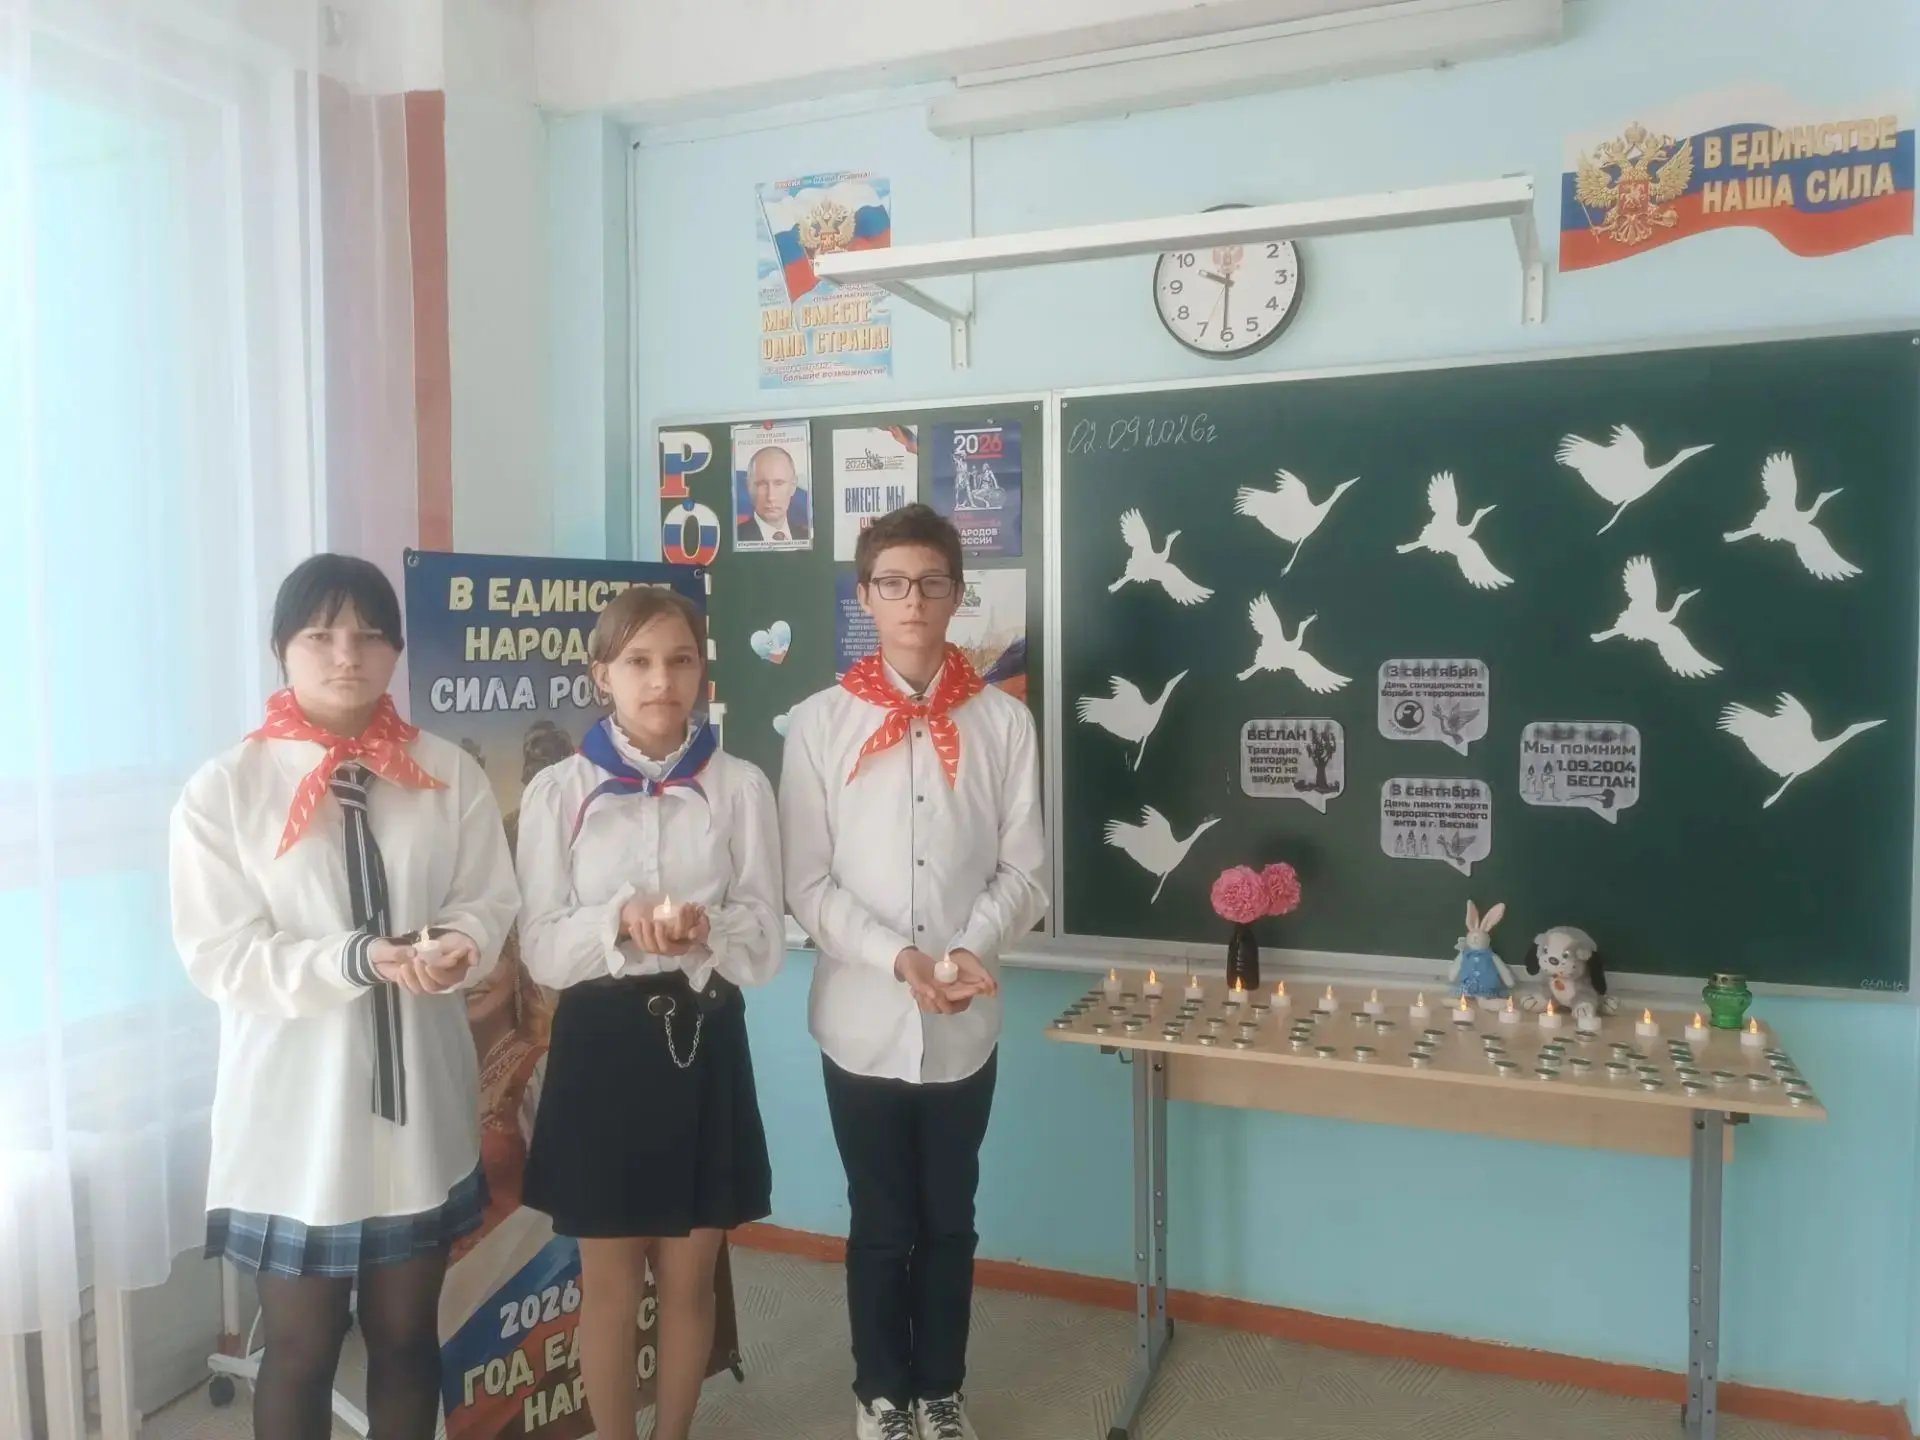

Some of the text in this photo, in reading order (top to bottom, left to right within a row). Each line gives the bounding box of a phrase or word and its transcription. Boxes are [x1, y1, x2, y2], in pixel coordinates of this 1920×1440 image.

[1703, 115, 1897, 170] В ЕДИНСТВЕ
[1701, 163, 1897, 214] НАША СИЛА
[1266, 243, 1279, 259] 2
[1176, 252, 1195, 268] 10
[1274, 269, 1288, 285] 3
[1169, 280, 1183, 294] 9
[1265, 296, 1279, 311] 4
[801, 299, 873, 328] ВМЕСТЕ
[1177, 305, 1190, 320] 8
[1197, 321, 1209, 337] 7
[1246, 317, 1259, 332] 5
[1220, 327, 1234, 342] 6
[761, 326, 891, 362] ОДНА СТРАНА!
[953, 434, 1003, 454] 2026
[845, 485, 905, 513] ВМЕСТЕ МЫ
[959, 528, 998, 537] АРОДОВ
[959, 536, 993, 545] ОССИИ
[449, 577, 671, 618] В ЕДИНСТ
[465, 627, 597, 666] НАРОД
[1390, 665, 1478, 679] 3 сентября
[431, 676, 537, 712] СИЛА
[1247, 729, 1306, 741] БЕСЛАН
[1524, 740, 1636, 755] Мы помним
[1250, 757, 1298, 765] которую
[1556, 759, 1636, 773] 1.09.2004
[1567, 774, 1636, 788] БЕСЛАН
[1406, 785, 1480, 799] сентября
[1384, 799, 1411, 808] День
[1439, 820, 1478, 829] Беслан
[500, 1280, 581, 1339] 2026
[464, 1349, 535, 1407] ГОД
